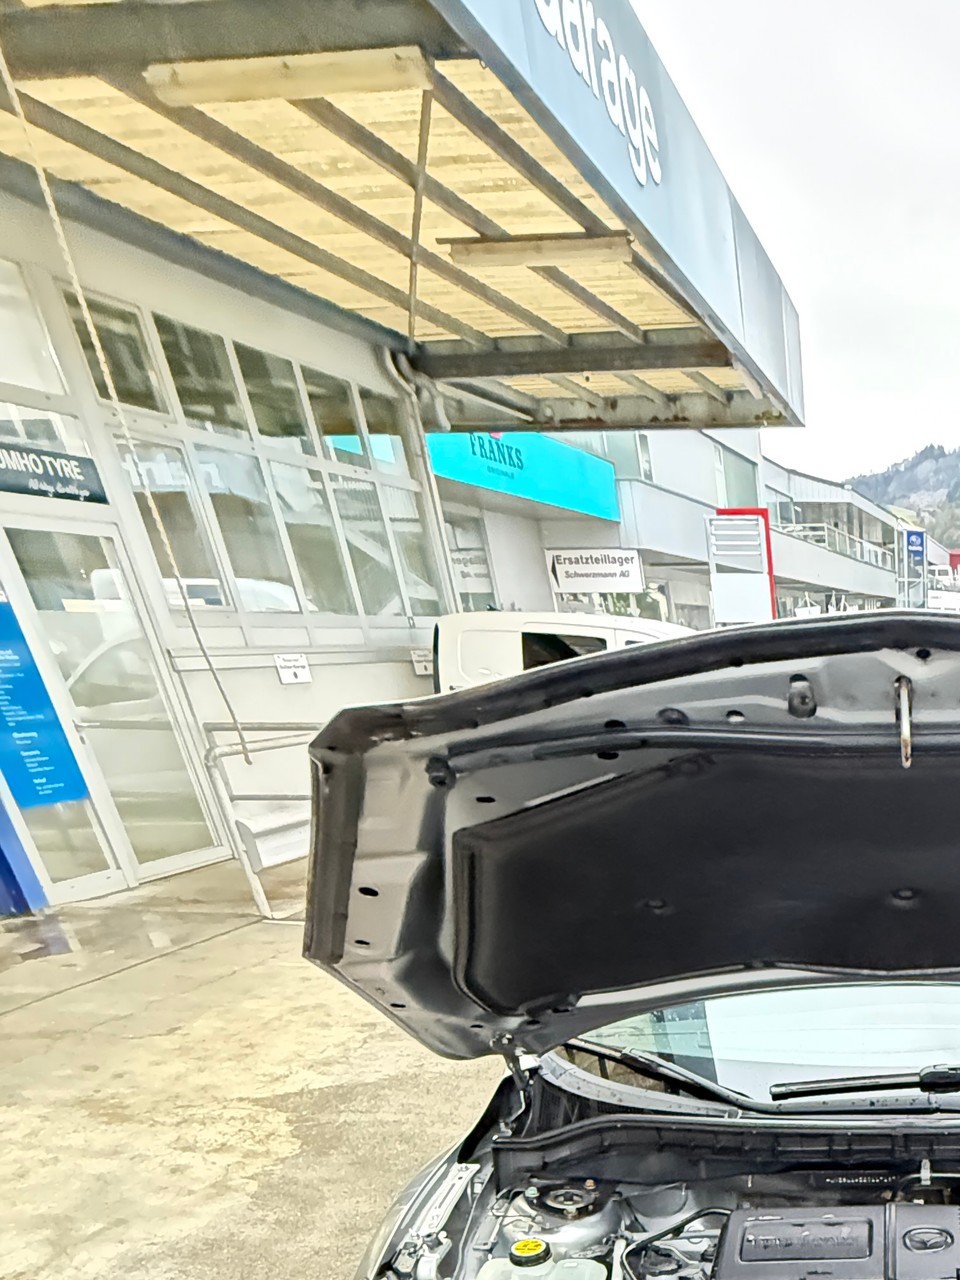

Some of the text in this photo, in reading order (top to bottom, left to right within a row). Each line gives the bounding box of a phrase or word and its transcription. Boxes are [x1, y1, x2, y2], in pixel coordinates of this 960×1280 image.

[469, 432, 524, 470] FRANKS
[40, 455, 85, 481] TYRE
[555, 554, 635, 567] Ersatzteillager
[618, 570, 630, 578] AG
